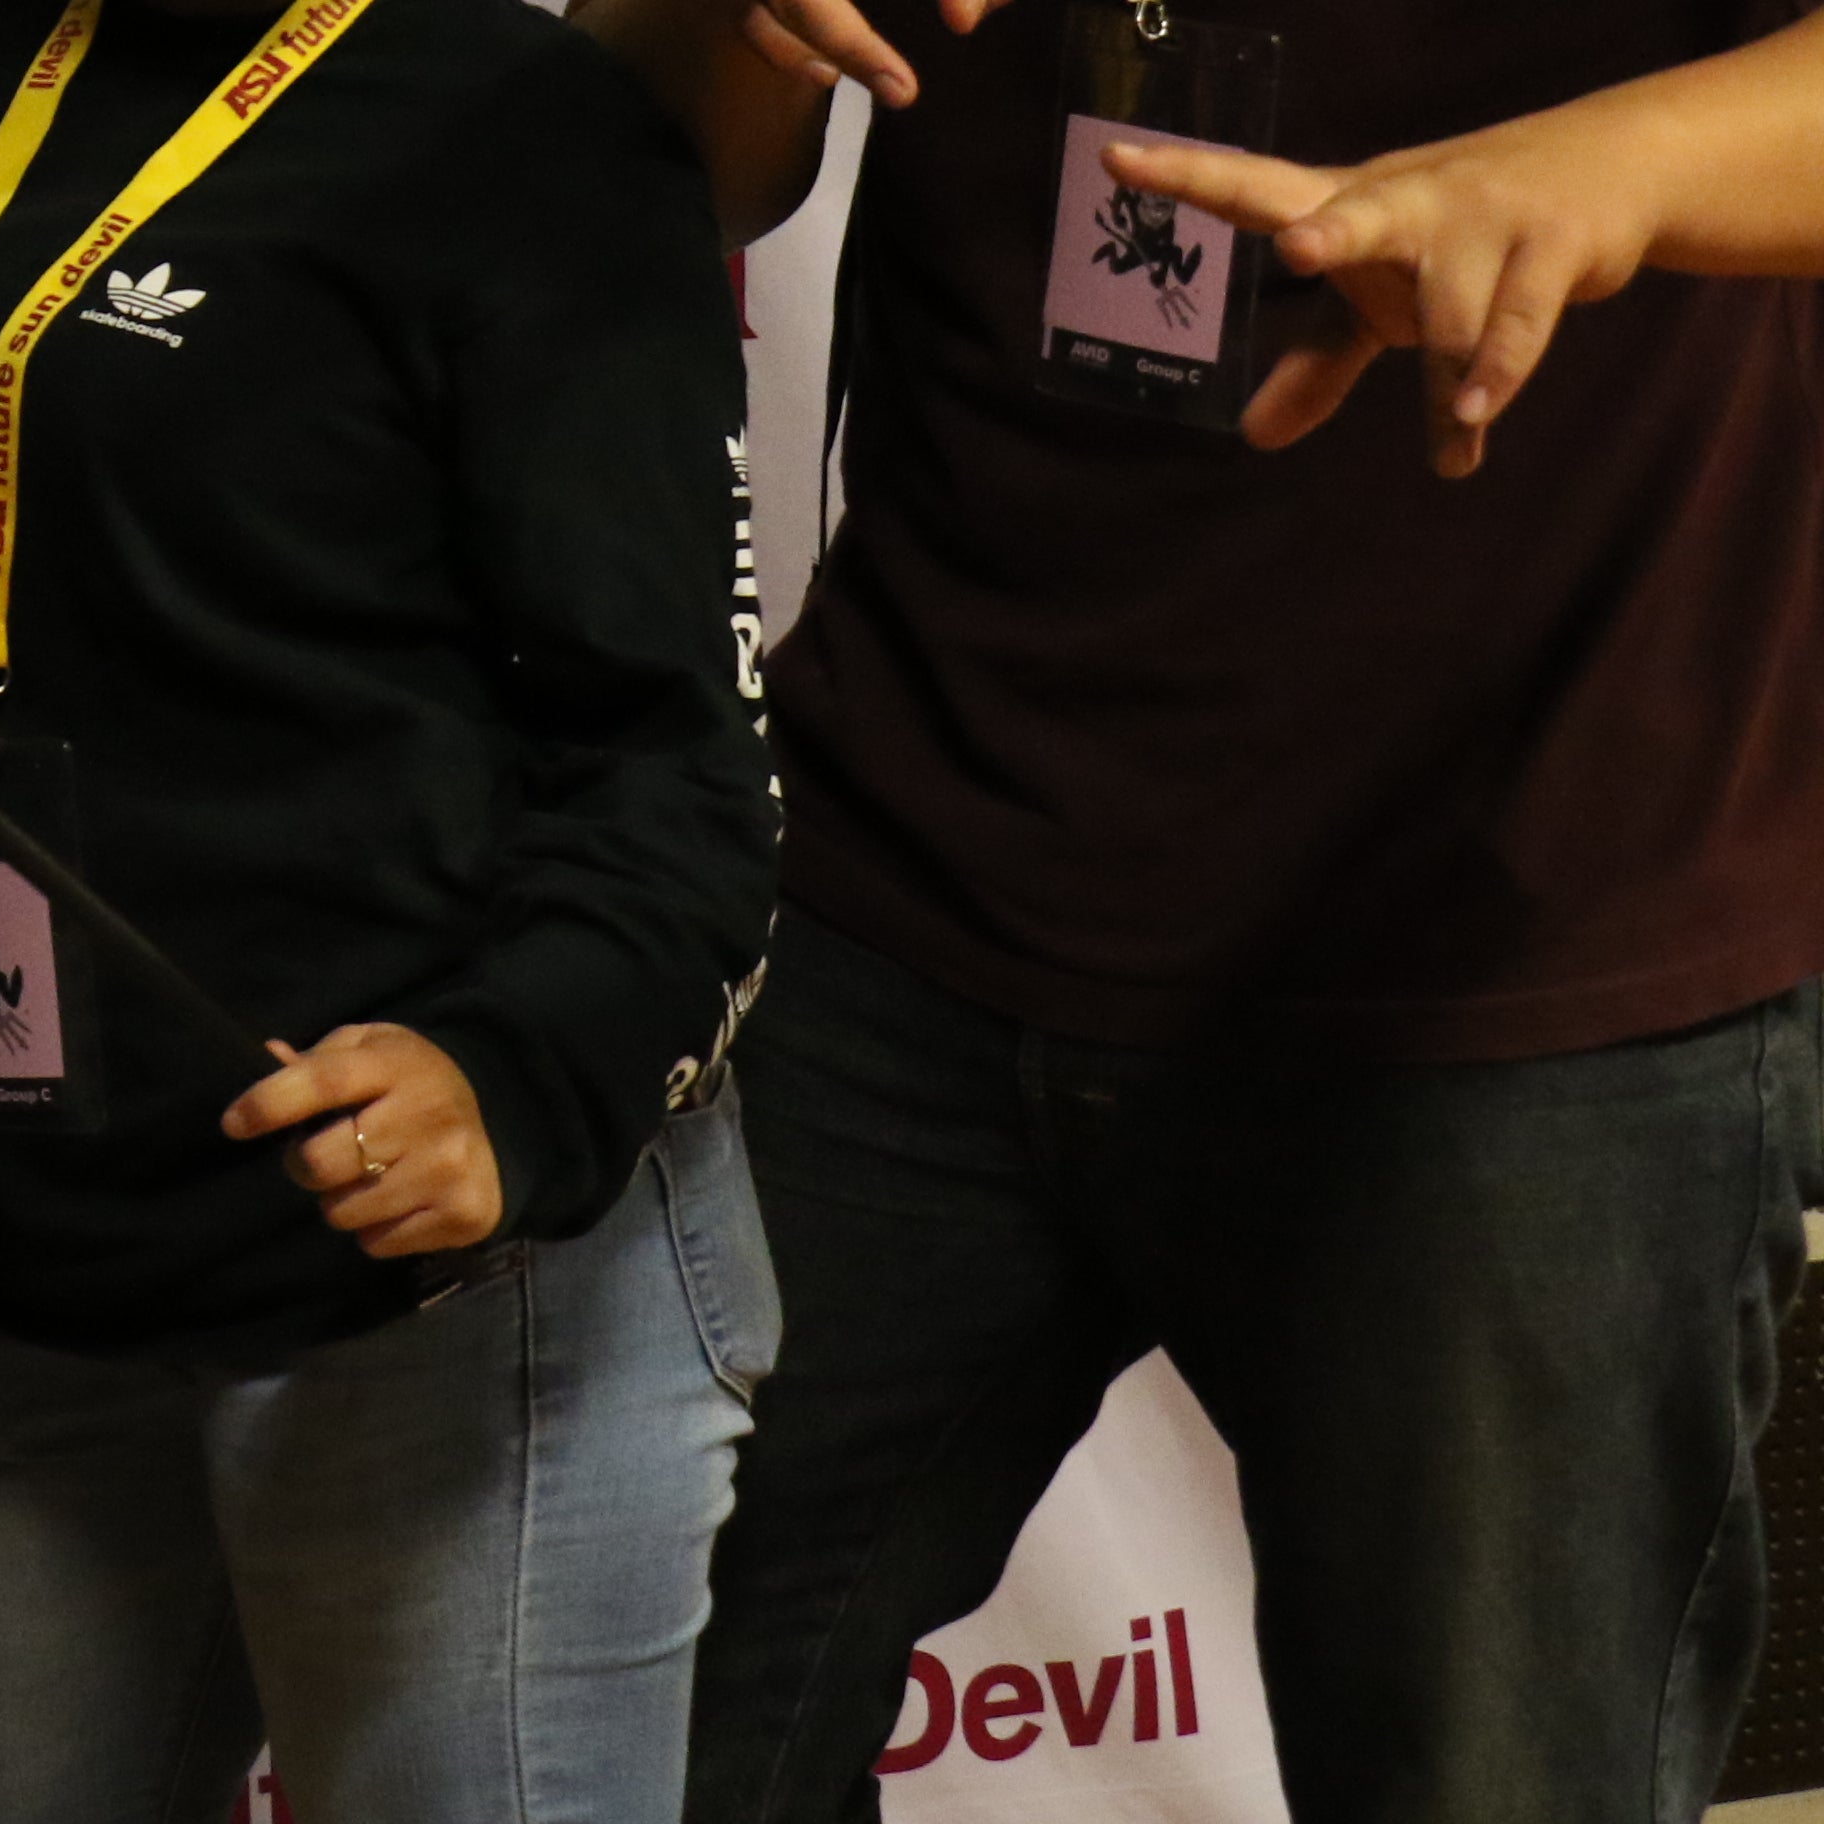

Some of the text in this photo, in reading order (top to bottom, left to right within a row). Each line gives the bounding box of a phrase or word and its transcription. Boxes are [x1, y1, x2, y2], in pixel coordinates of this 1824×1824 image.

[221, 45, 293, 120] ASU
[8, 294, 63, 355] sun
[60, 212, 134, 289] devil
[78, 308, 185, 349] skateboarding
[1136, 357, 1184, 384] Group
